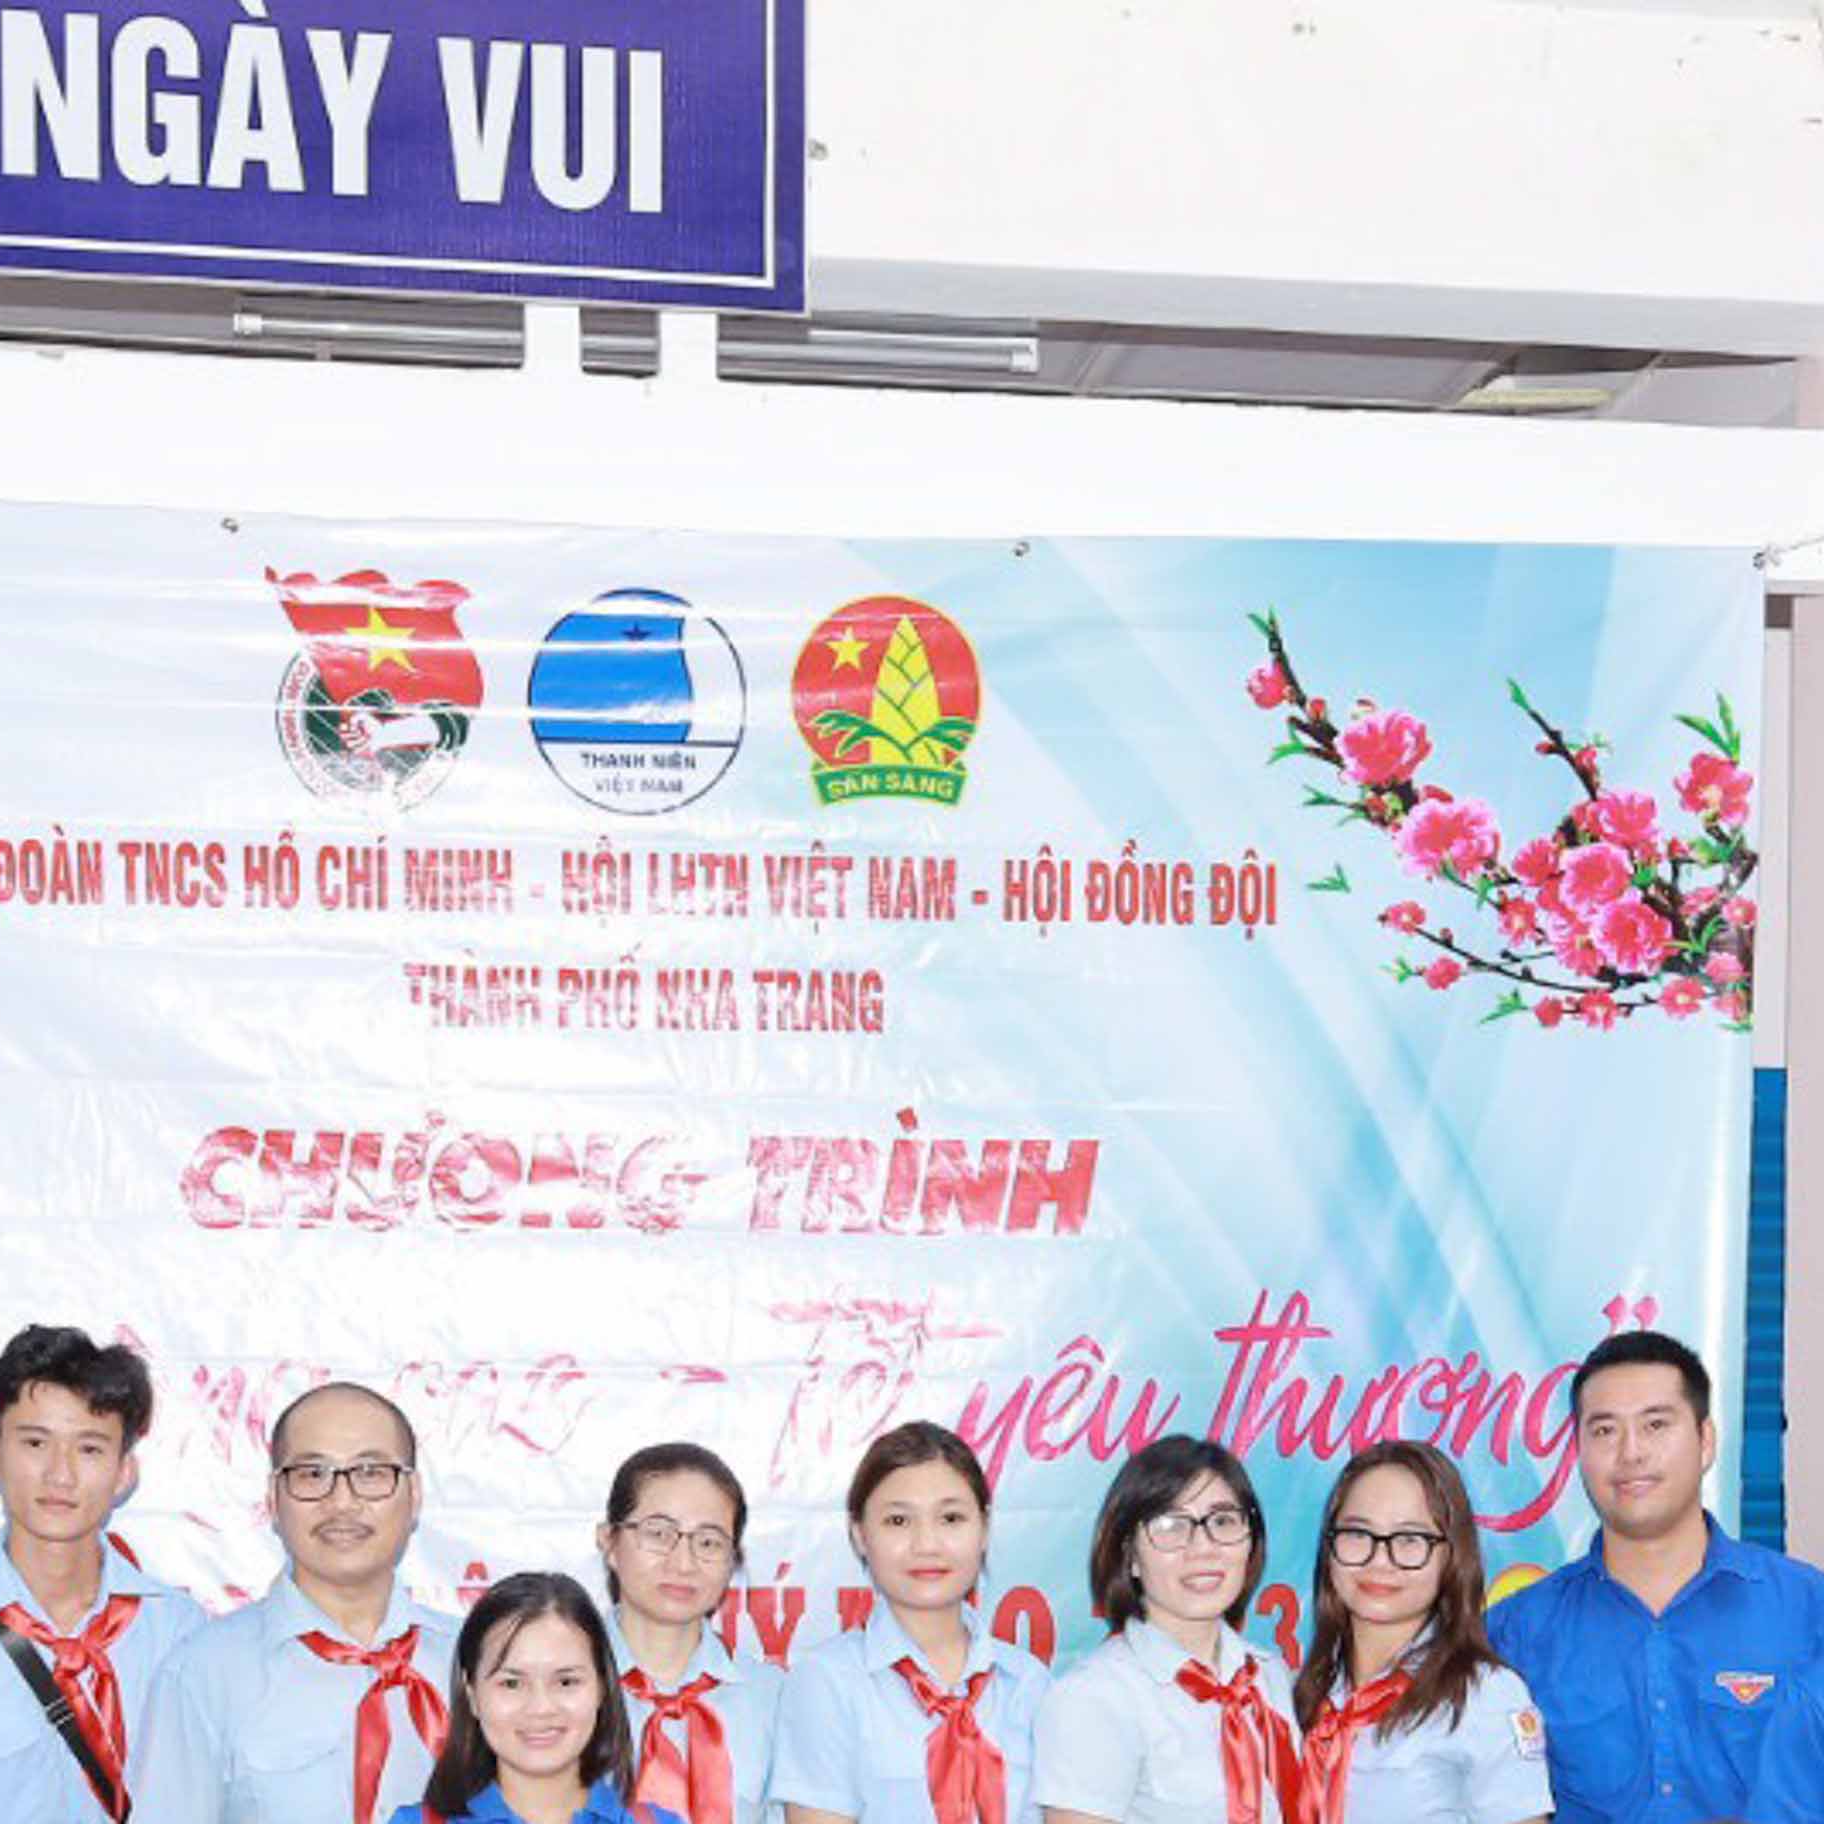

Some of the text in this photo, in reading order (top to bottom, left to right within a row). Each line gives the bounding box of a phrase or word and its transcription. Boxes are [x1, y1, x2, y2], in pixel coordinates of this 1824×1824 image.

[1, 0, 393, 197] NGÀY
[437, 35, 663, 213] VUI
[118, 837, 226, 908] TNCS
[316, 834, 390, 912] CHÍ
[403, 847, 514, 914] MINH
[763, 840, 854, 935] VIỆT
[868, 856, 957, 922] NAM
[1002, 844, 1073, 938] HỘI
[1207, 848, 1277, 940] ĐỘI
[403, 946, 542, 1030] THÀNH
[752, 968, 885, 1034] TRANG
[955, 1335, 1181, 1510] yêu
